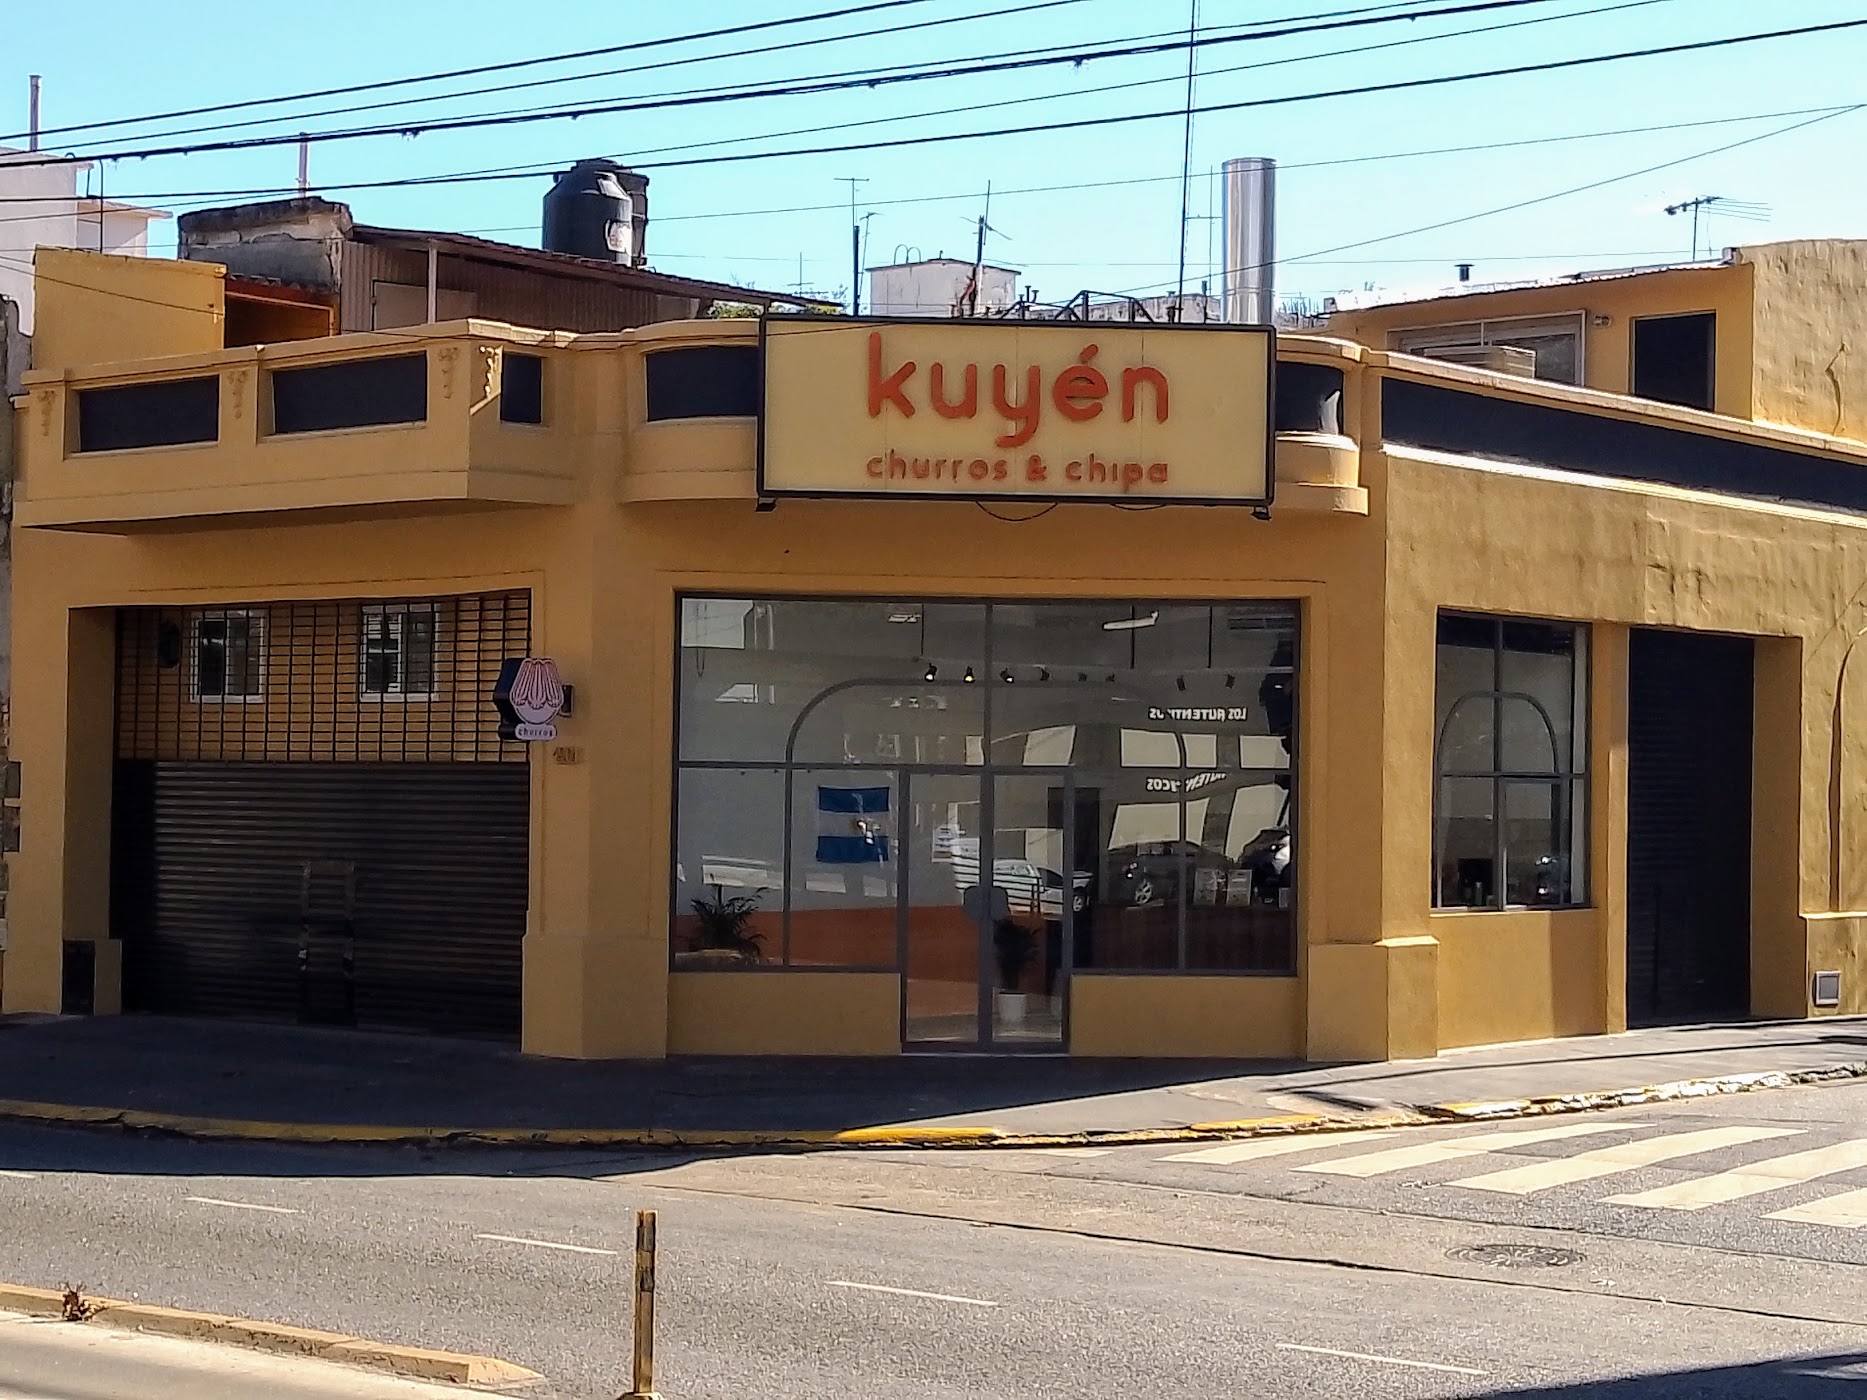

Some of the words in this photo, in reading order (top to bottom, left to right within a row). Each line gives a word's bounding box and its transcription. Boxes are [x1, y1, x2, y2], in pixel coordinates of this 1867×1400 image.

[867, 331, 1170, 449] kuyén
[866, 448, 1009, 482] churros
[1026, 454, 1047, 482] &
[1065, 452, 1169, 494] chipa
[518, 727, 553, 737] churros
